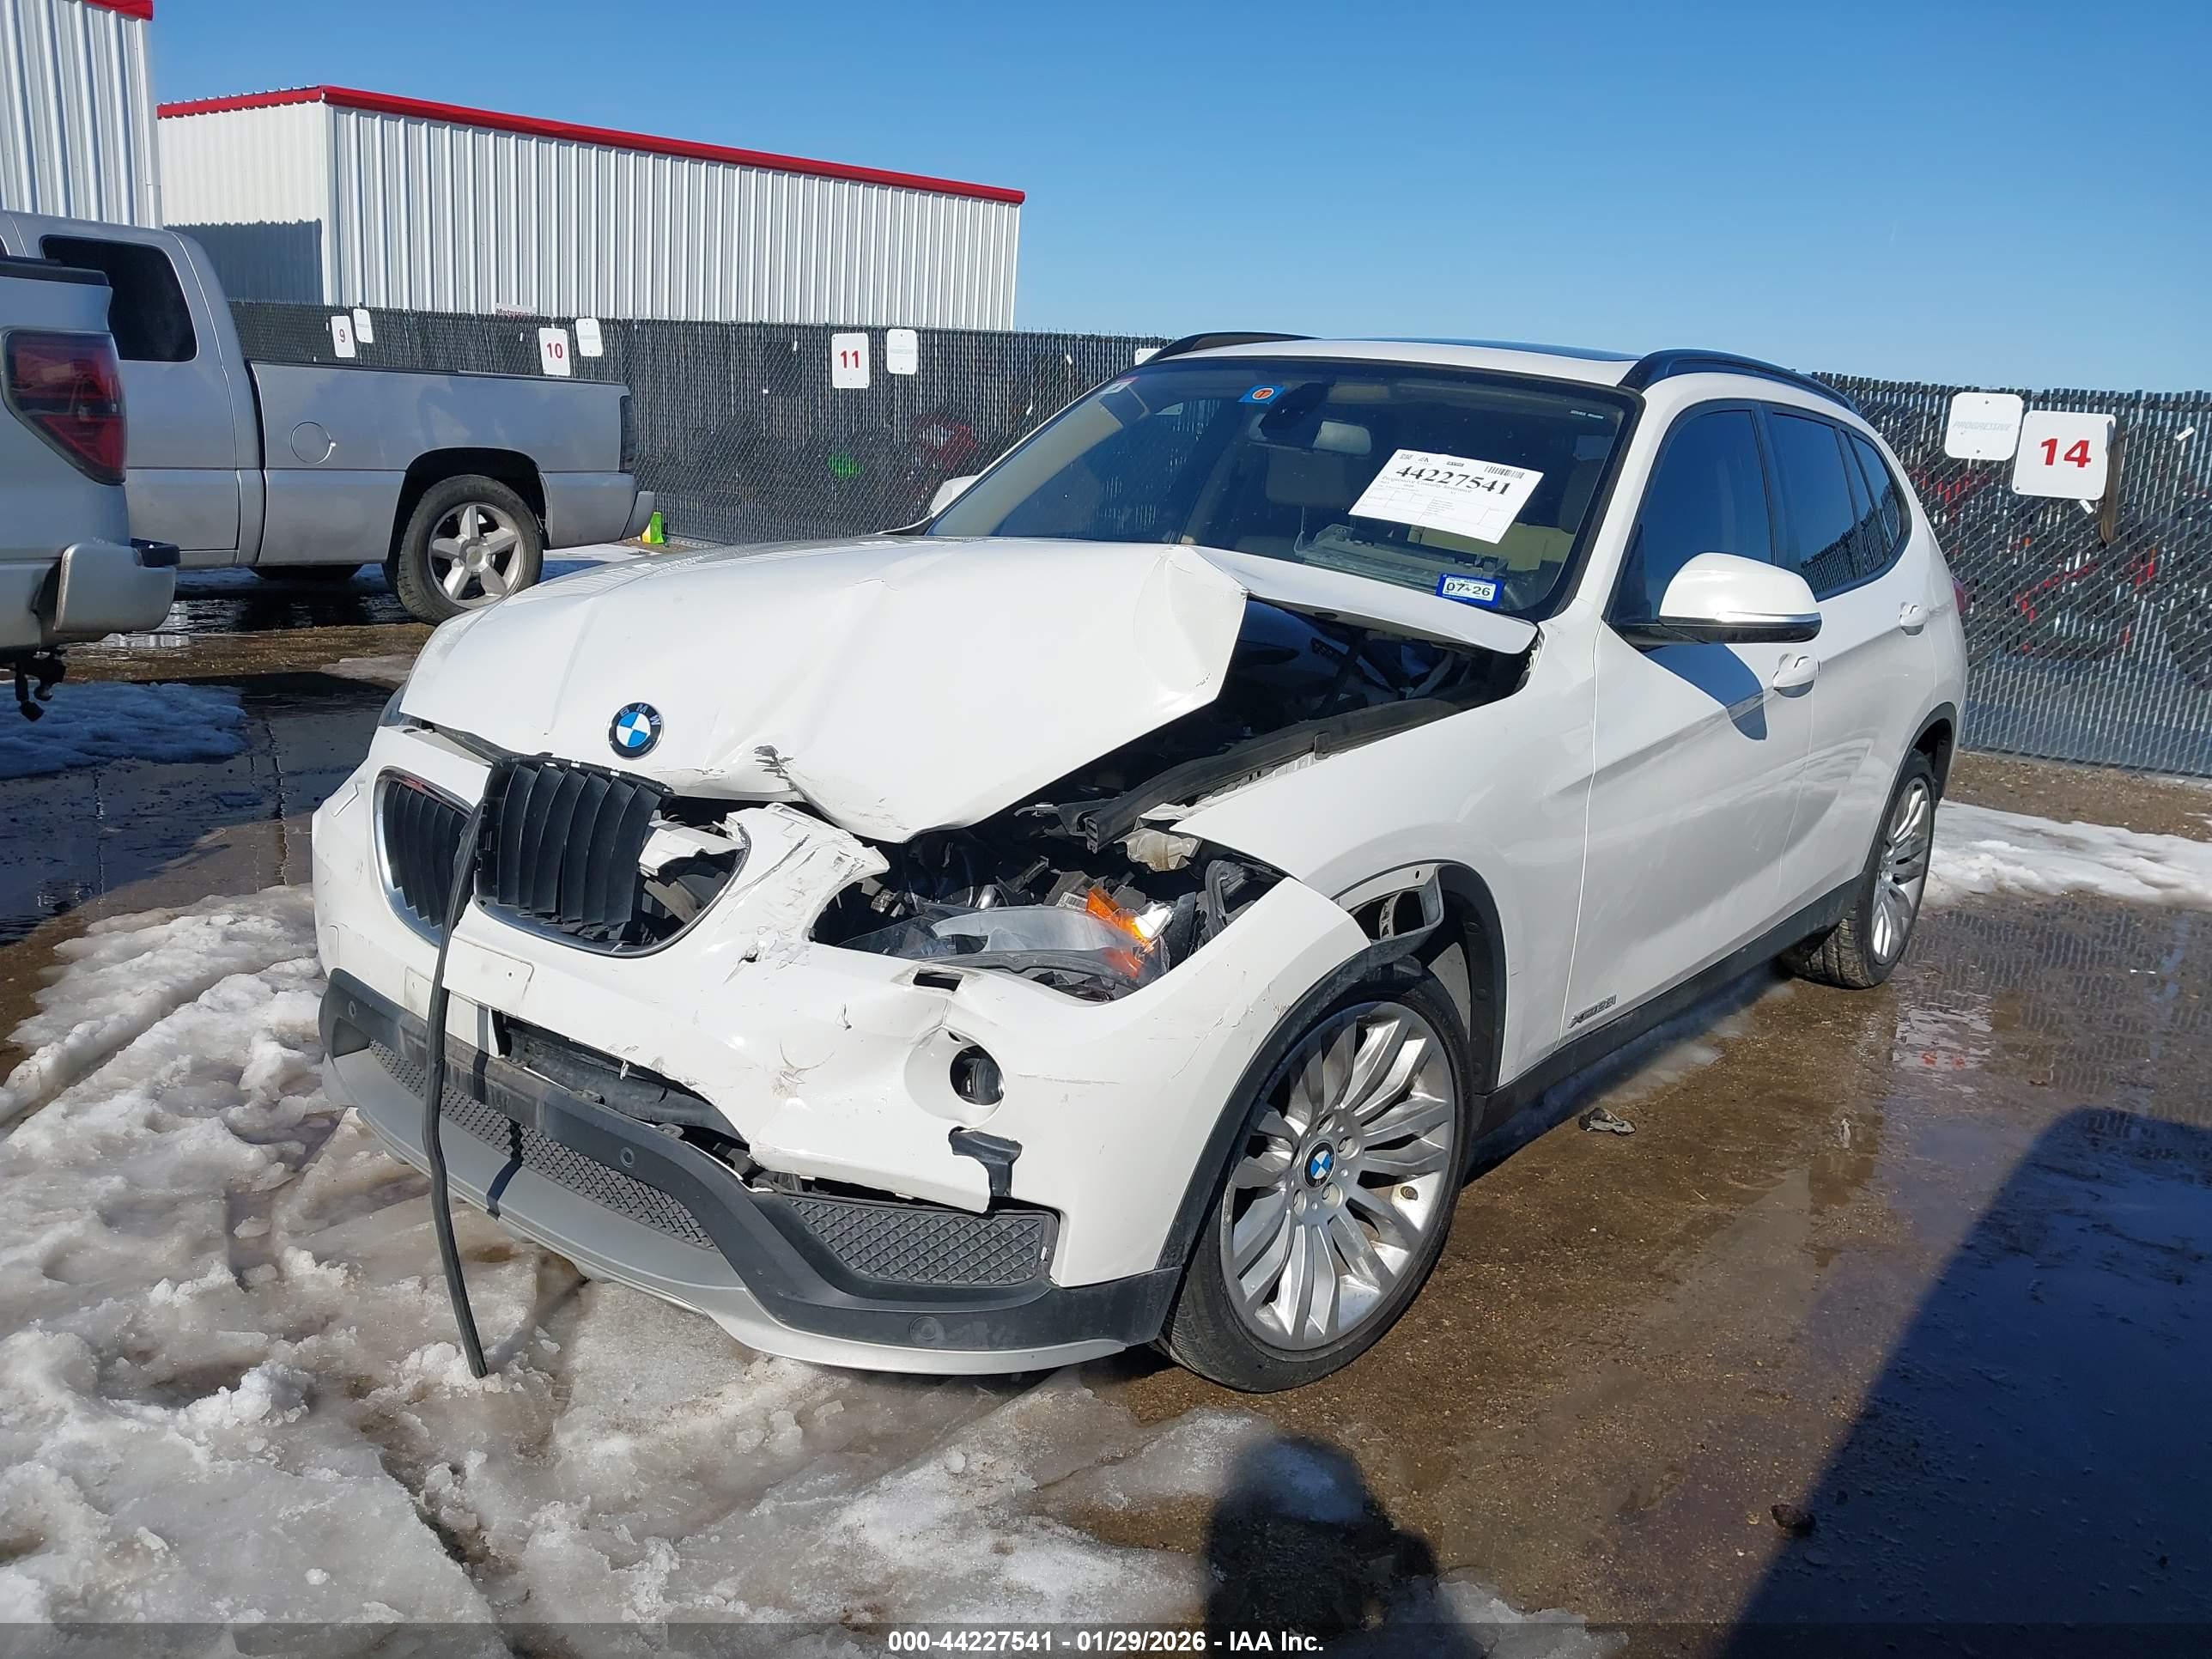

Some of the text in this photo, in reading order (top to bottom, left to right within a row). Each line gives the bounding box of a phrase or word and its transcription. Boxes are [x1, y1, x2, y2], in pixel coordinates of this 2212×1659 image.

[339, 328, 346, 343] 9
[546, 343, 562, 359] 10
[840, 350, 860, 368] 11
[2040, 438, 2092, 468] 14
[1395, 465, 1511, 495] 44227541
[619, 703, 661, 726] BMW
